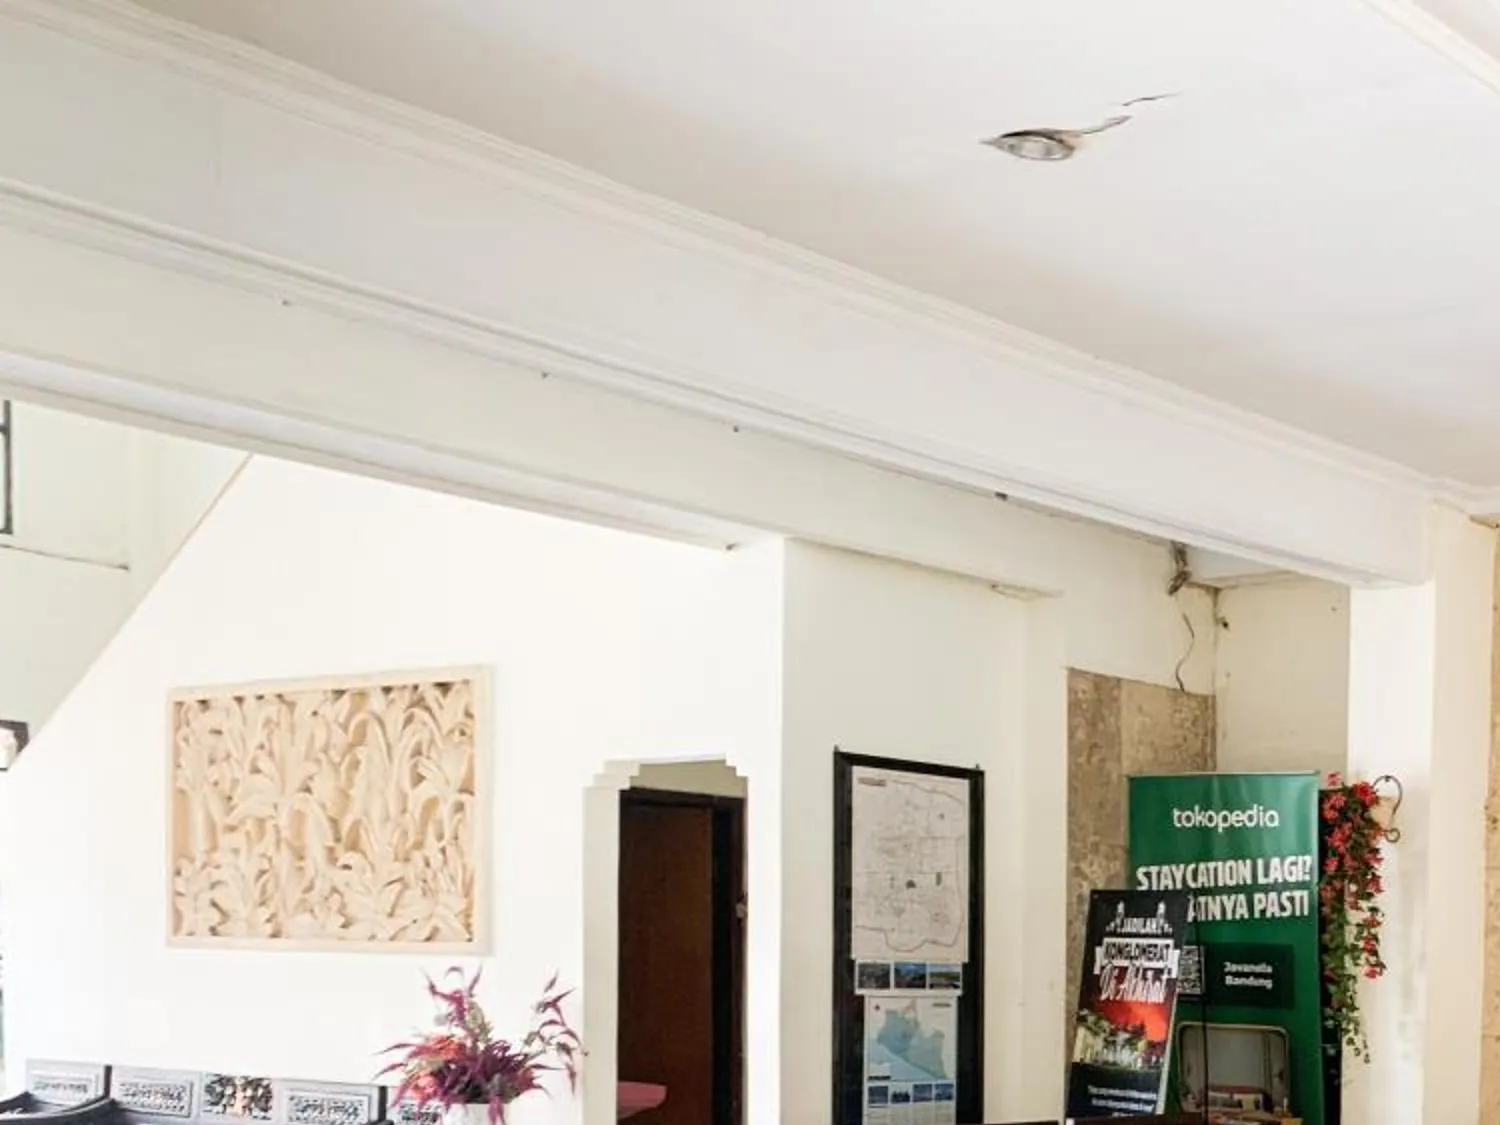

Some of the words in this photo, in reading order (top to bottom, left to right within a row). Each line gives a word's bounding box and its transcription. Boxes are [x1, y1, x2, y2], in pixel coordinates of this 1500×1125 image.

[1173, 804, 1280, 833] tokopedia
[1136, 859, 1252, 890] STAYCATION
[1186, 893, 1249, 922] ATNYA
[1254, 890, 1310, 917] PASTI
